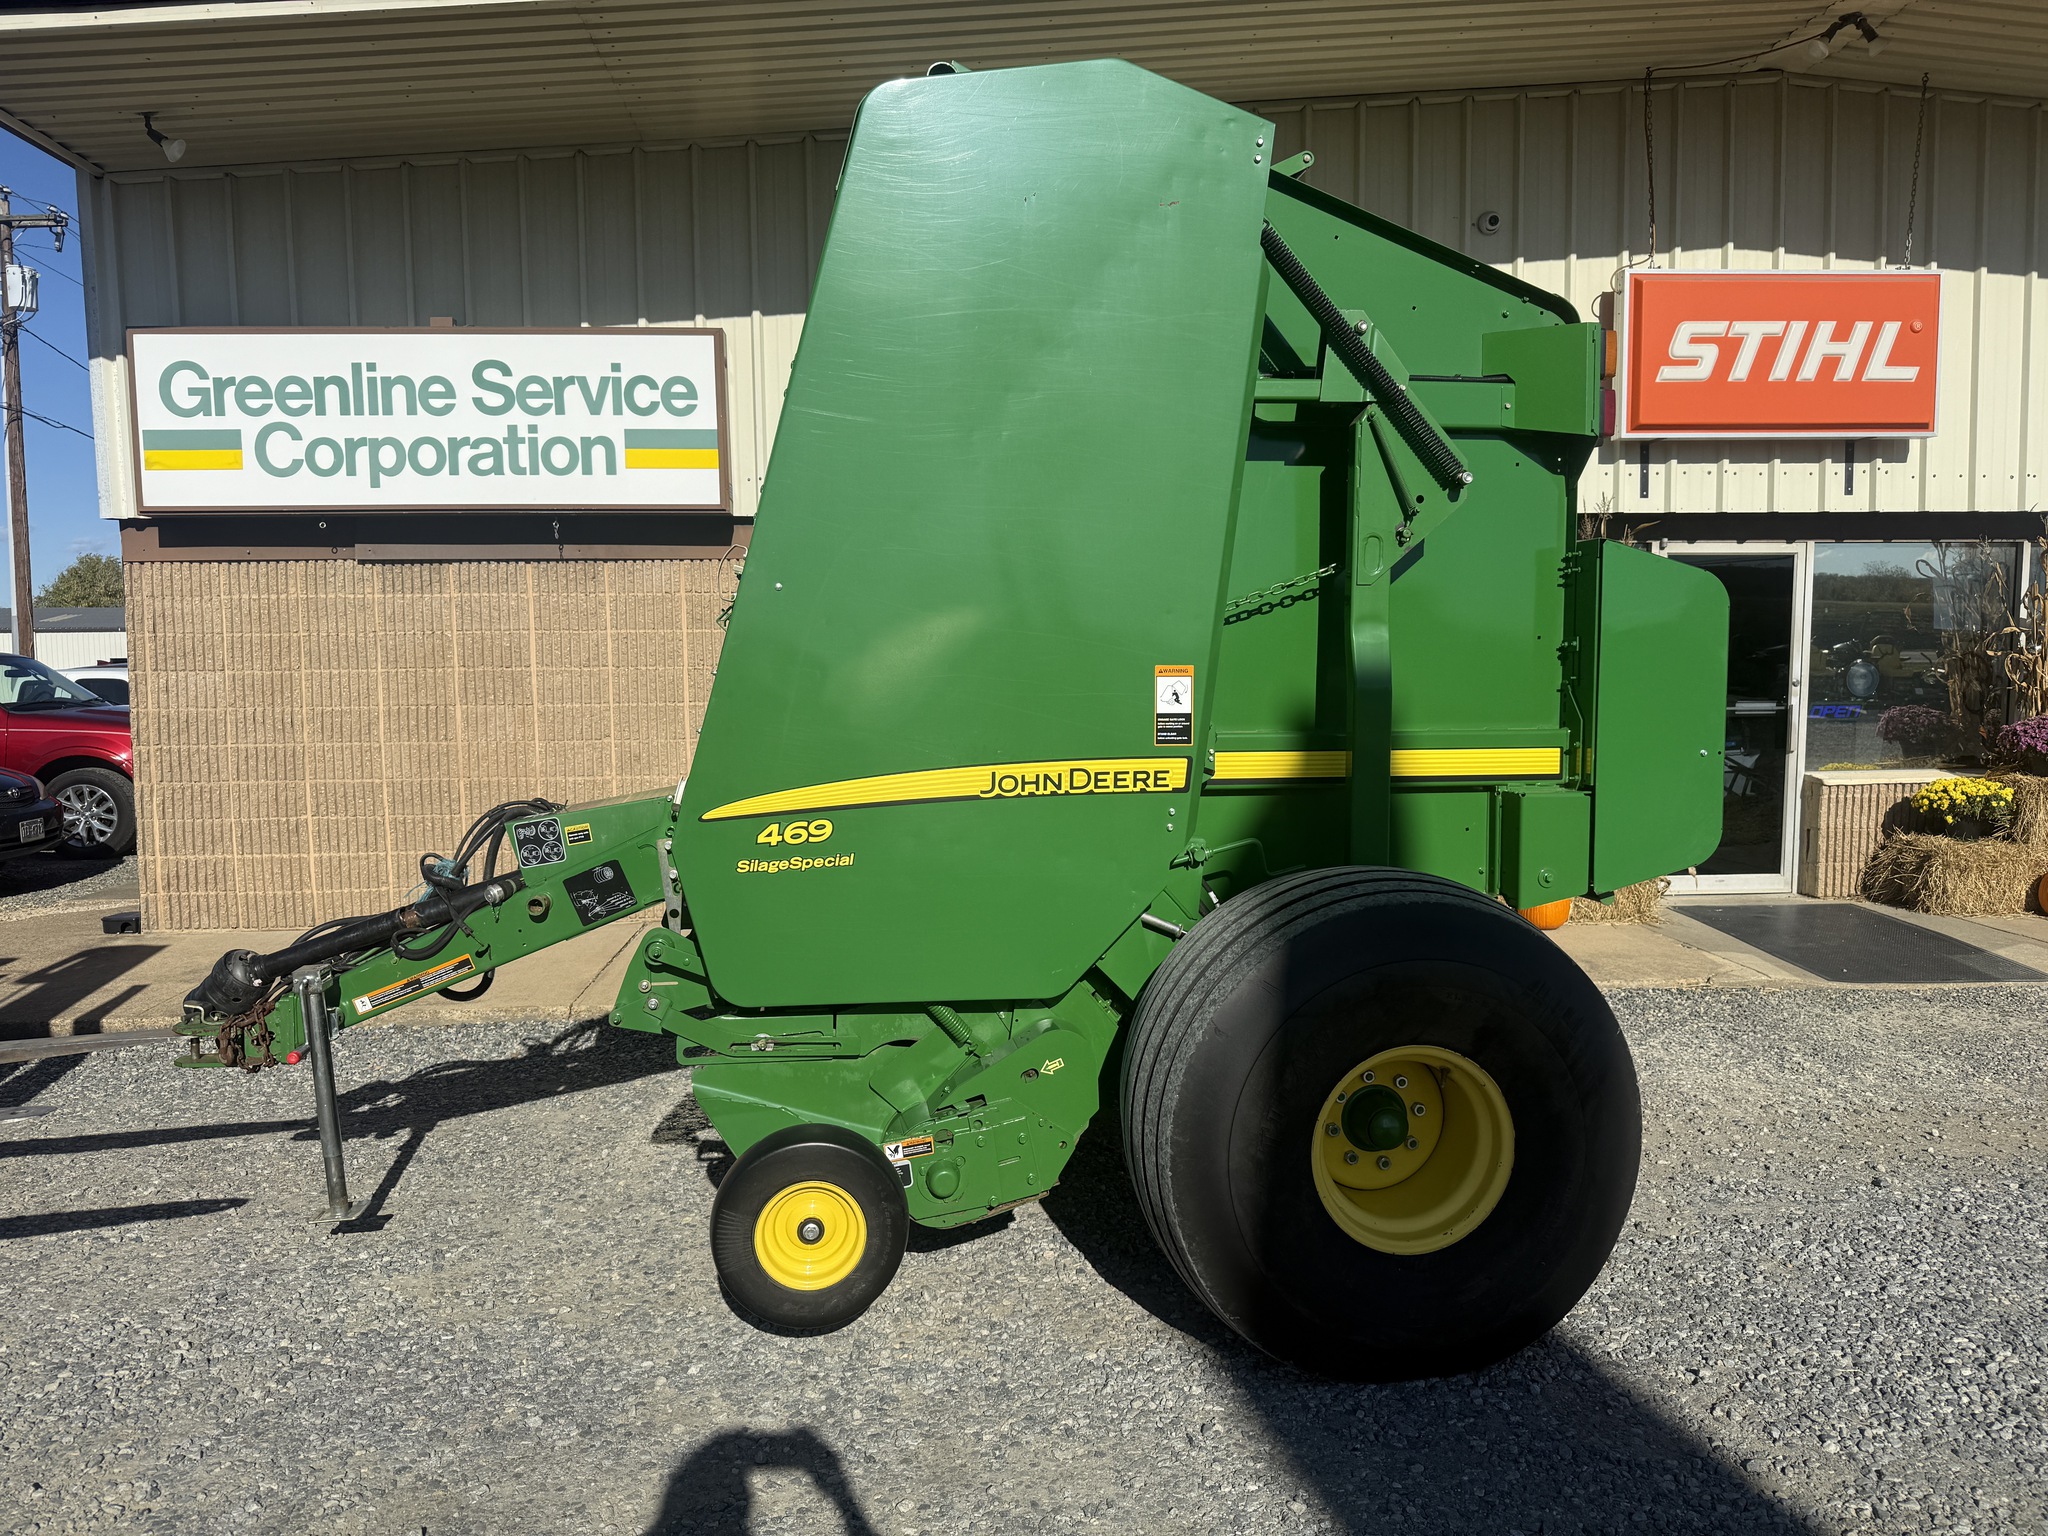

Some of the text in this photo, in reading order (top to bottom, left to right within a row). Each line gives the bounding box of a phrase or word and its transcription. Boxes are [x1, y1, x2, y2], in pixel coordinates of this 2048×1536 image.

[1655, 320, 1921, 383] STIHL
[158, 359, 699, 418] Greenline Service
[254, 421, 618, 489] Corporation
[1810, 705, 1862, 719] OPEN
[980, 767, 1171, 797] JOHN DEERE
[756, 818, 834, 847] 469
[736, 852, 855, 874] SilageSpecial
